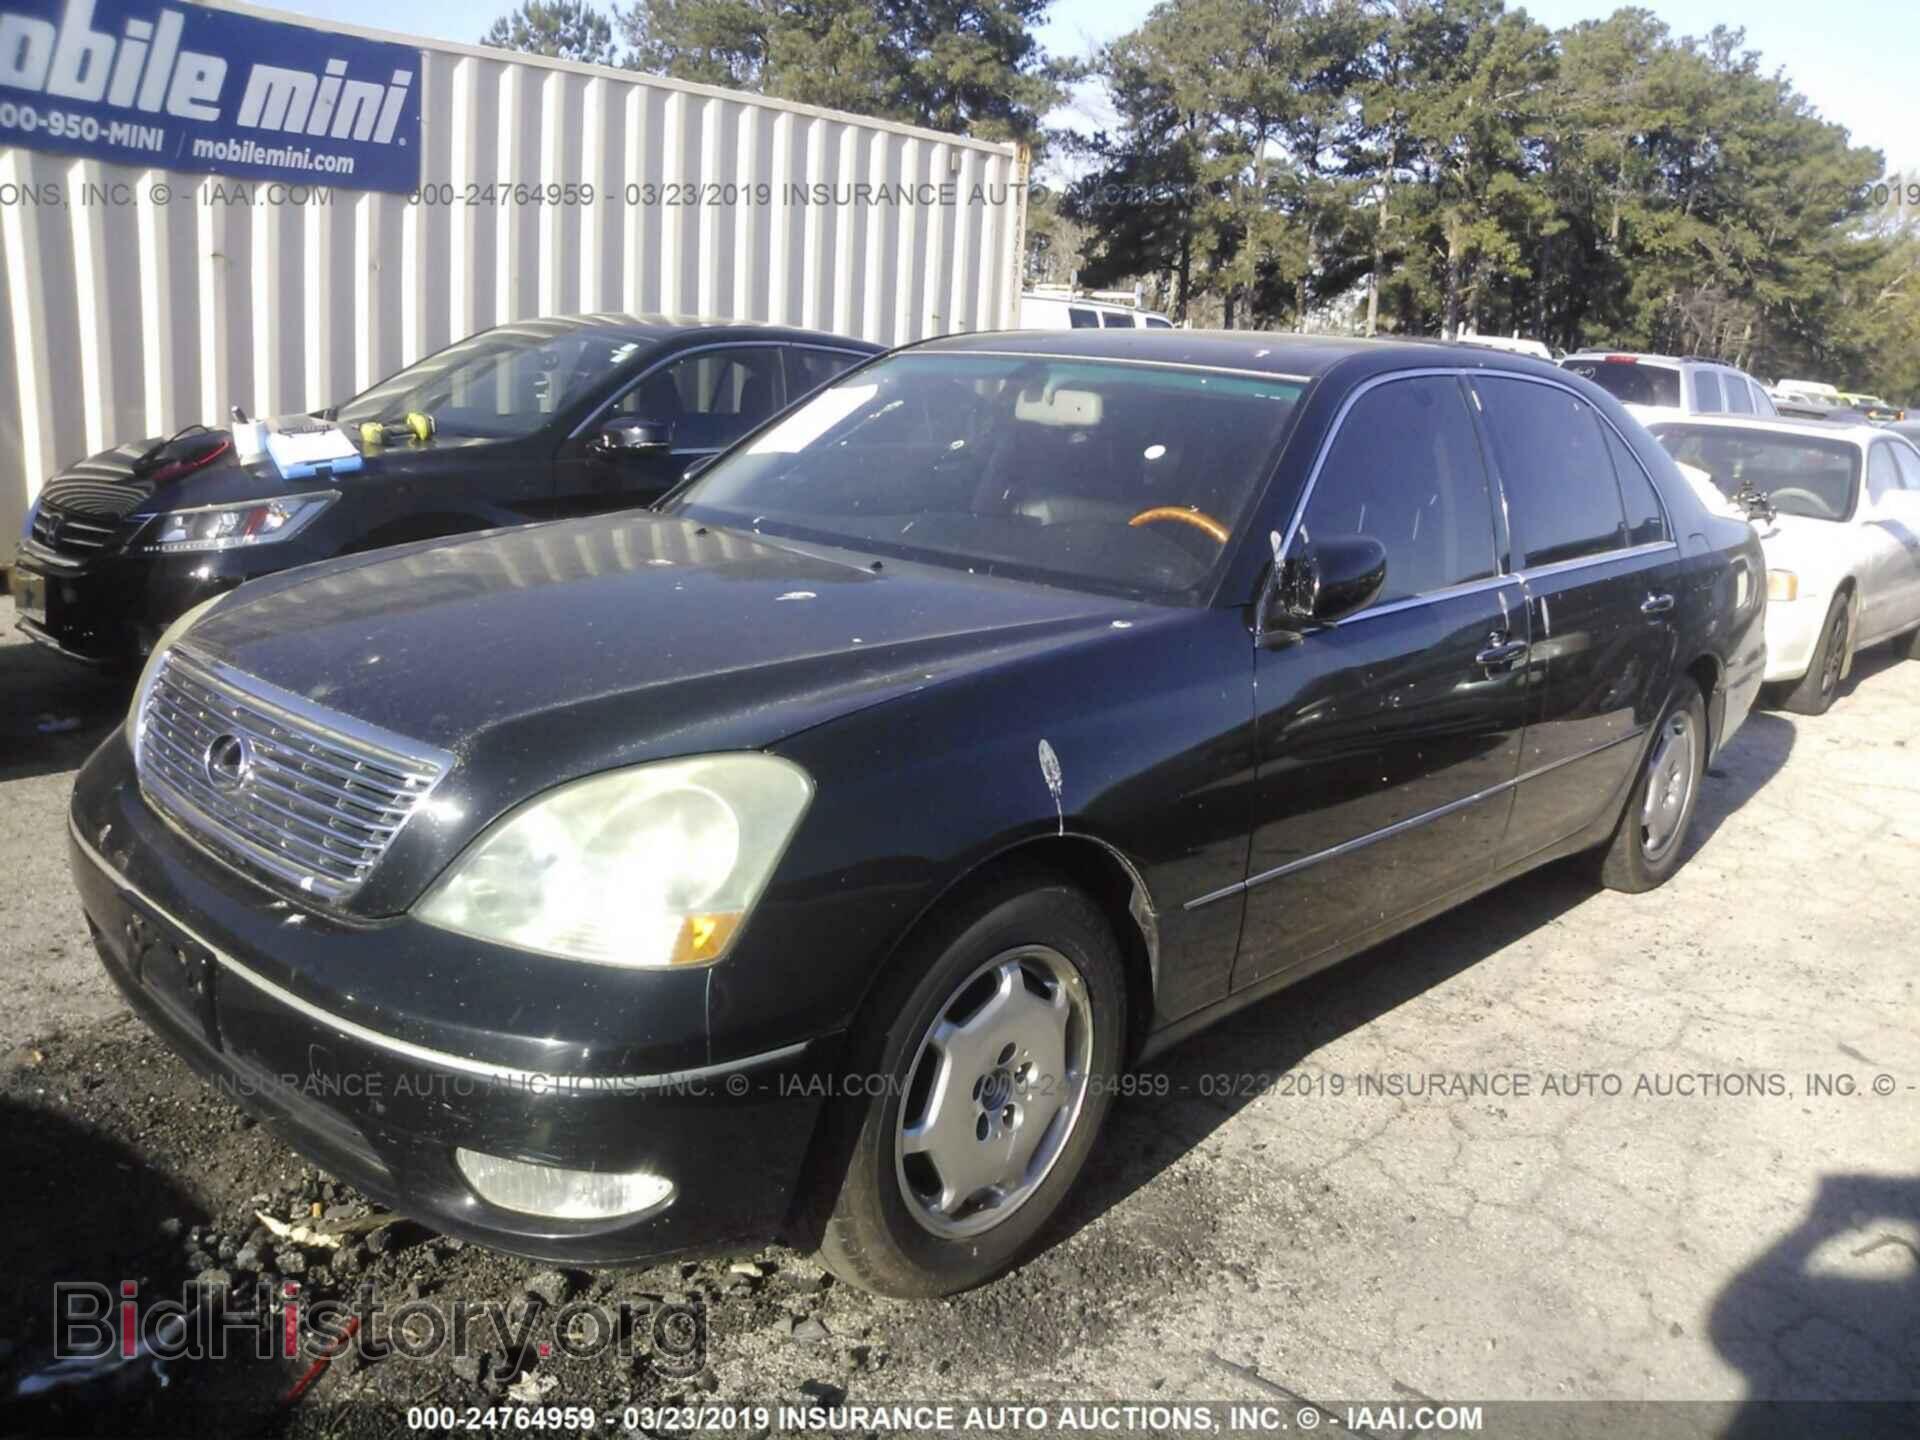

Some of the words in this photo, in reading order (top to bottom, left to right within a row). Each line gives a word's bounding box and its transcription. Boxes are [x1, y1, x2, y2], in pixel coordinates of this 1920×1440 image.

[0, 101, 165, 152] 00-950-MINI
[193, 135, 356, 174] mobilemini.com
[237, 58, 413, 144] mini
